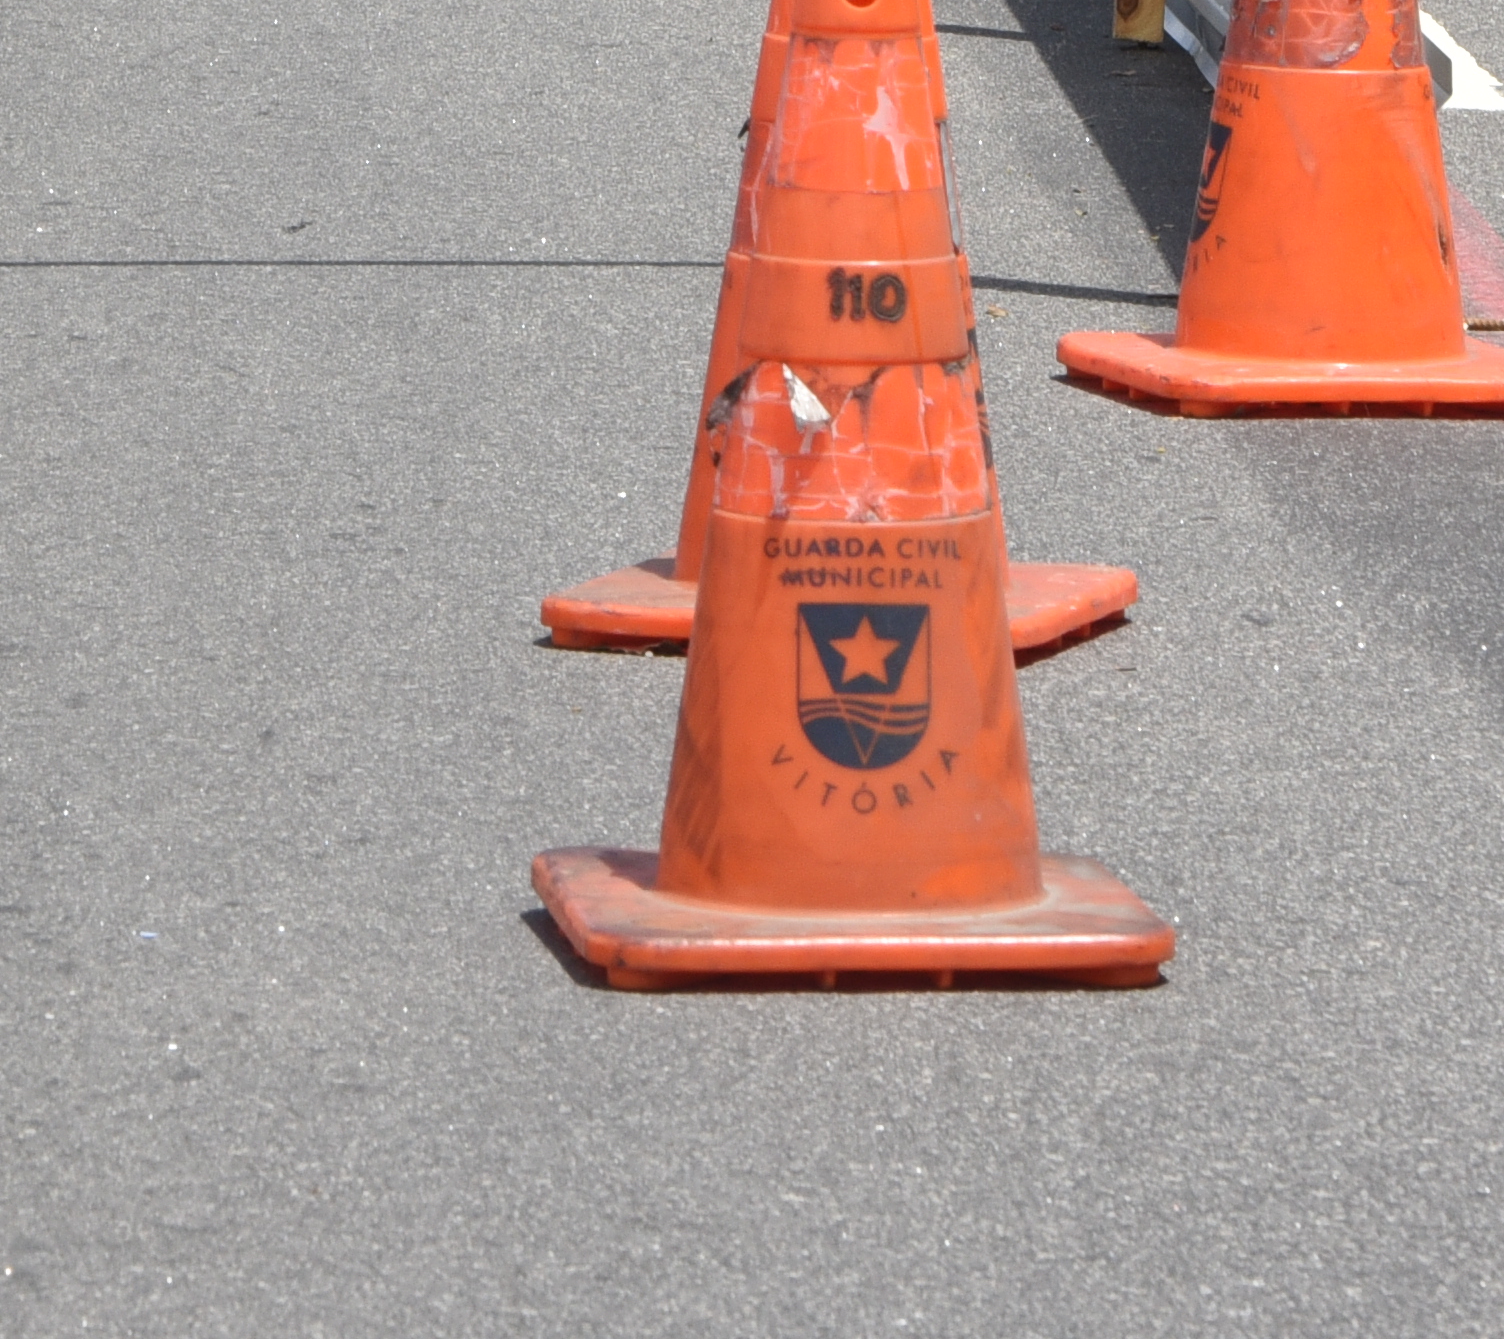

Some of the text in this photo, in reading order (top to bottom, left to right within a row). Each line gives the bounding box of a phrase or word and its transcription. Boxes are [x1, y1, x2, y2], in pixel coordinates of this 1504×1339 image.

[825, 267, 908, 325] 110
[763, 535, 963, 562] GUARDA CIVIL
[778, 564, 945, 590] MUNICIPAL
[769, 744, 962, 817] VITÓRIA
